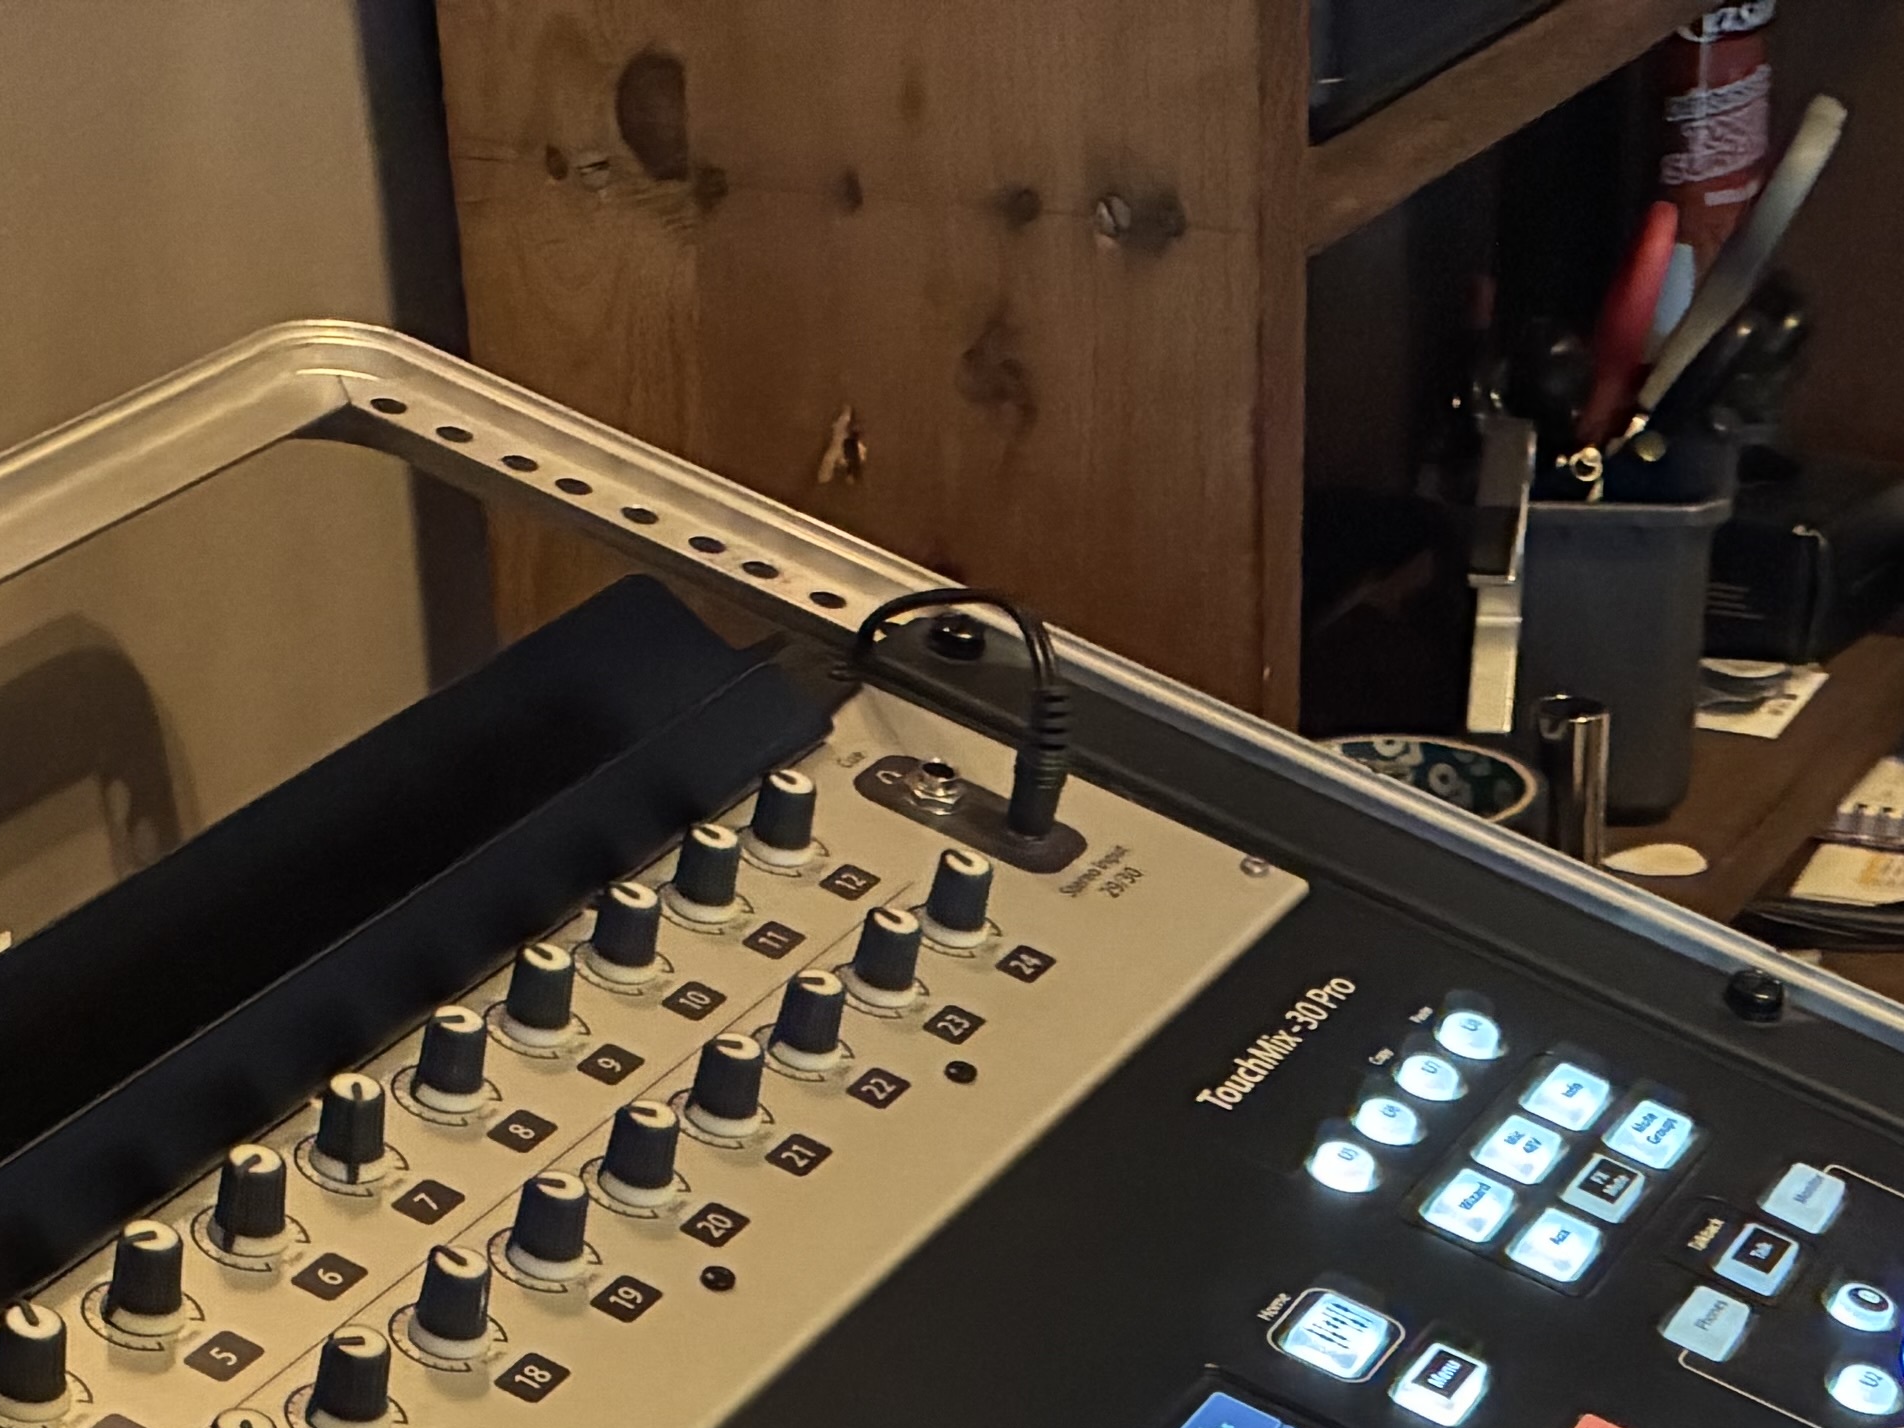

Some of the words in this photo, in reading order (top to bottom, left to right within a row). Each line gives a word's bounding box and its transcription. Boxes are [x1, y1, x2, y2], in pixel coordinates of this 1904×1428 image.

[835, 874, 867, 891] 12
[758, 931, 789, 950] 11
[1009, 954, 1044, 975] 24
[678, 990, 711, 1010] 10
[1314, 977, 1356, 1010] Pro
[937, 1015, 972, 1036] 23
[598, 1056, 622, 1072] 9
[861, 1077, 896, 1099] 22
[509, 1122, 536, 1139] 8
[781, 1144, 817, 1167] 21
[413, 1192, 439, 1210] 7
[698, 1213, 734, 1237] 20
[318, 1268, 343, 1285] 6
[609, 1286, 643, 1309] 19
[1257, 1292, 1291, 1321] Home
[1696, 1300, 1729, 1331] Phones
[209, 1346, 238, 1365] 5
[514, 1365, 551, 1389] 18
[1427, 1359, 1463, 1388] Menu
